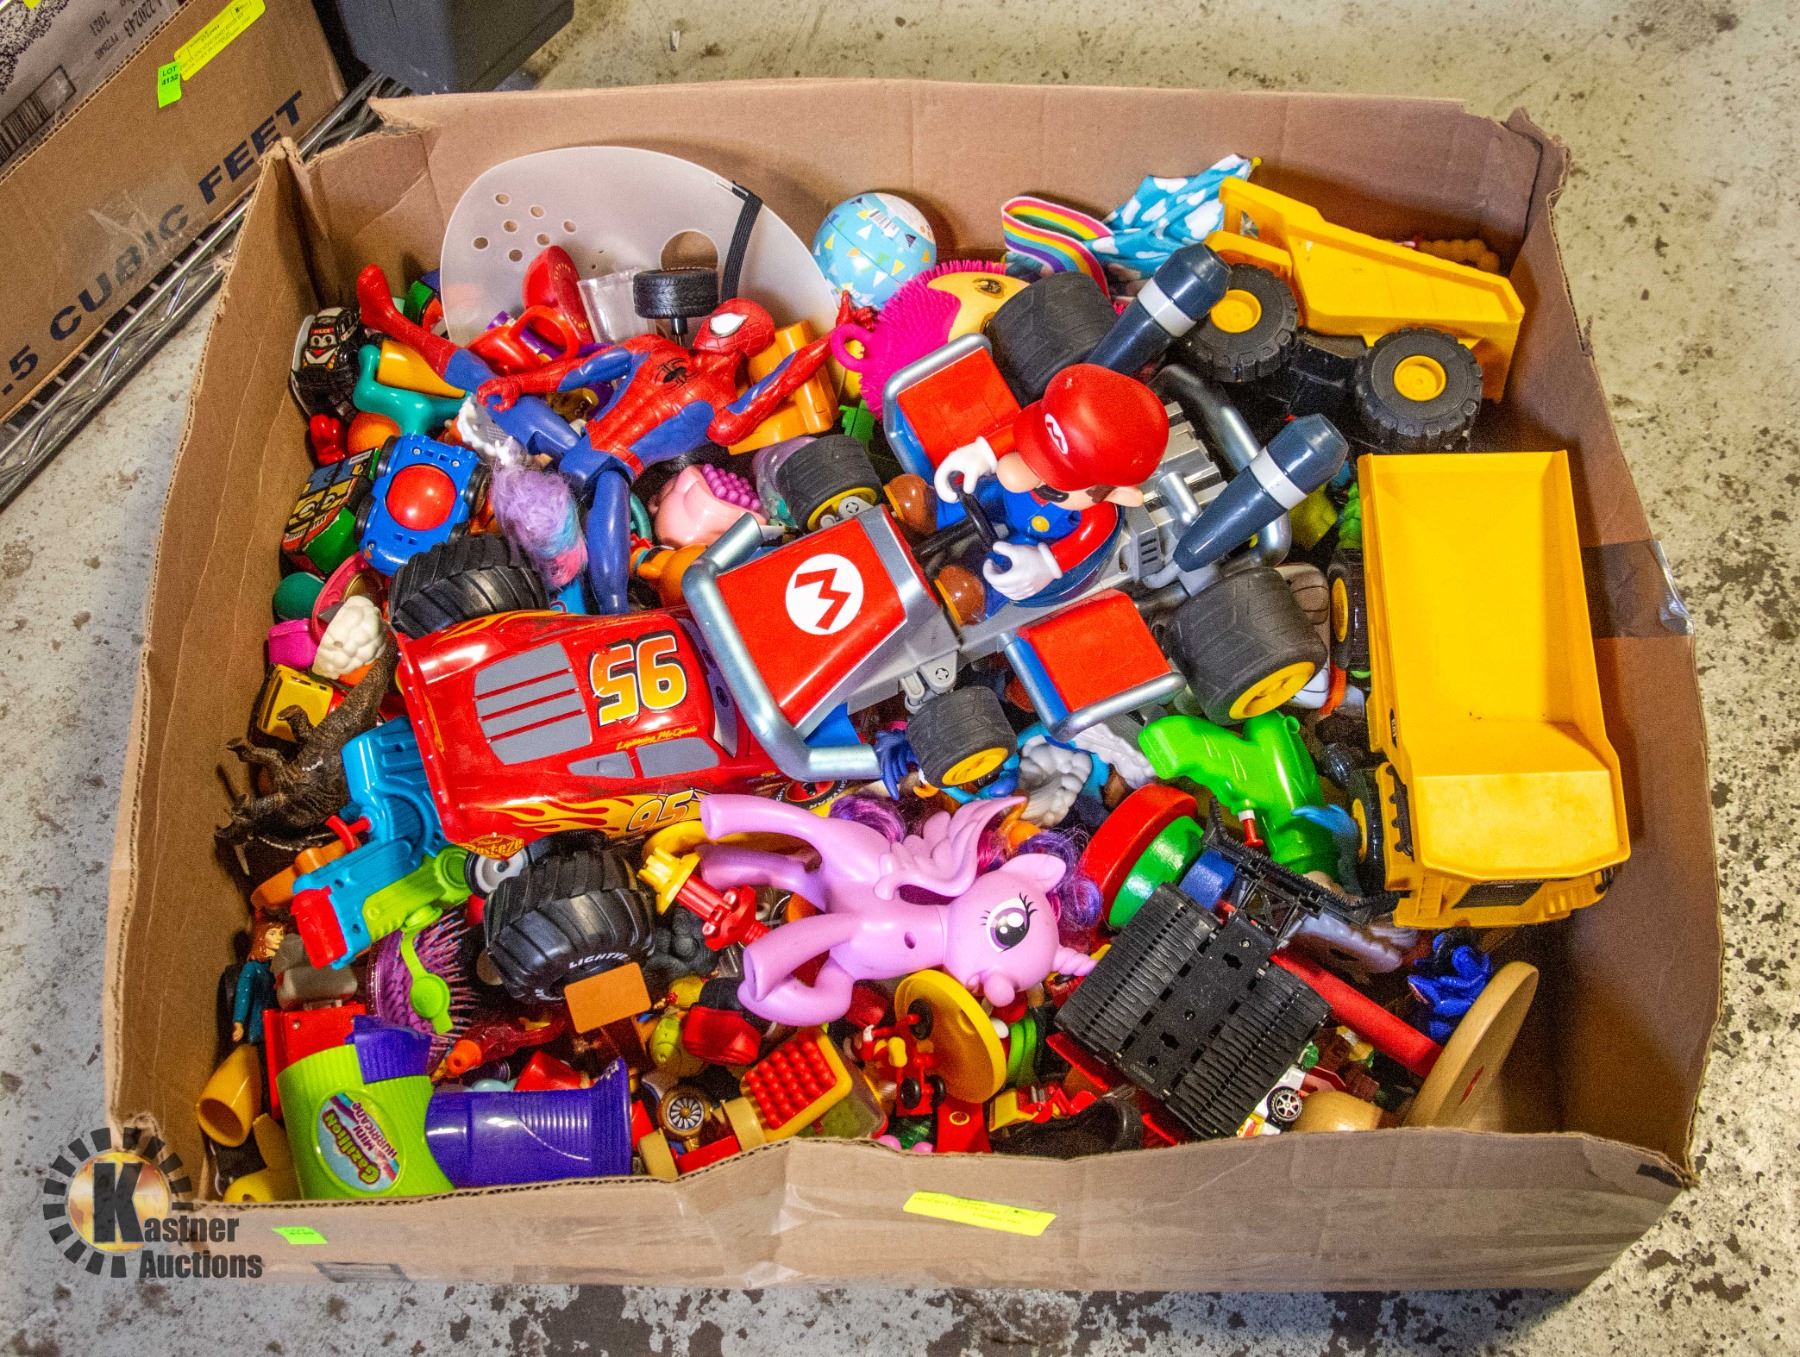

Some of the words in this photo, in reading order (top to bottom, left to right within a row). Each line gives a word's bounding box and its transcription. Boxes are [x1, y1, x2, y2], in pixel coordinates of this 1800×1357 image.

[162, 65, 177, 77] LOT
[50, 204, 189, 342] CUBIC
[198, 89, 303, 205] FEET
[626, 789, 695, 833] 95
